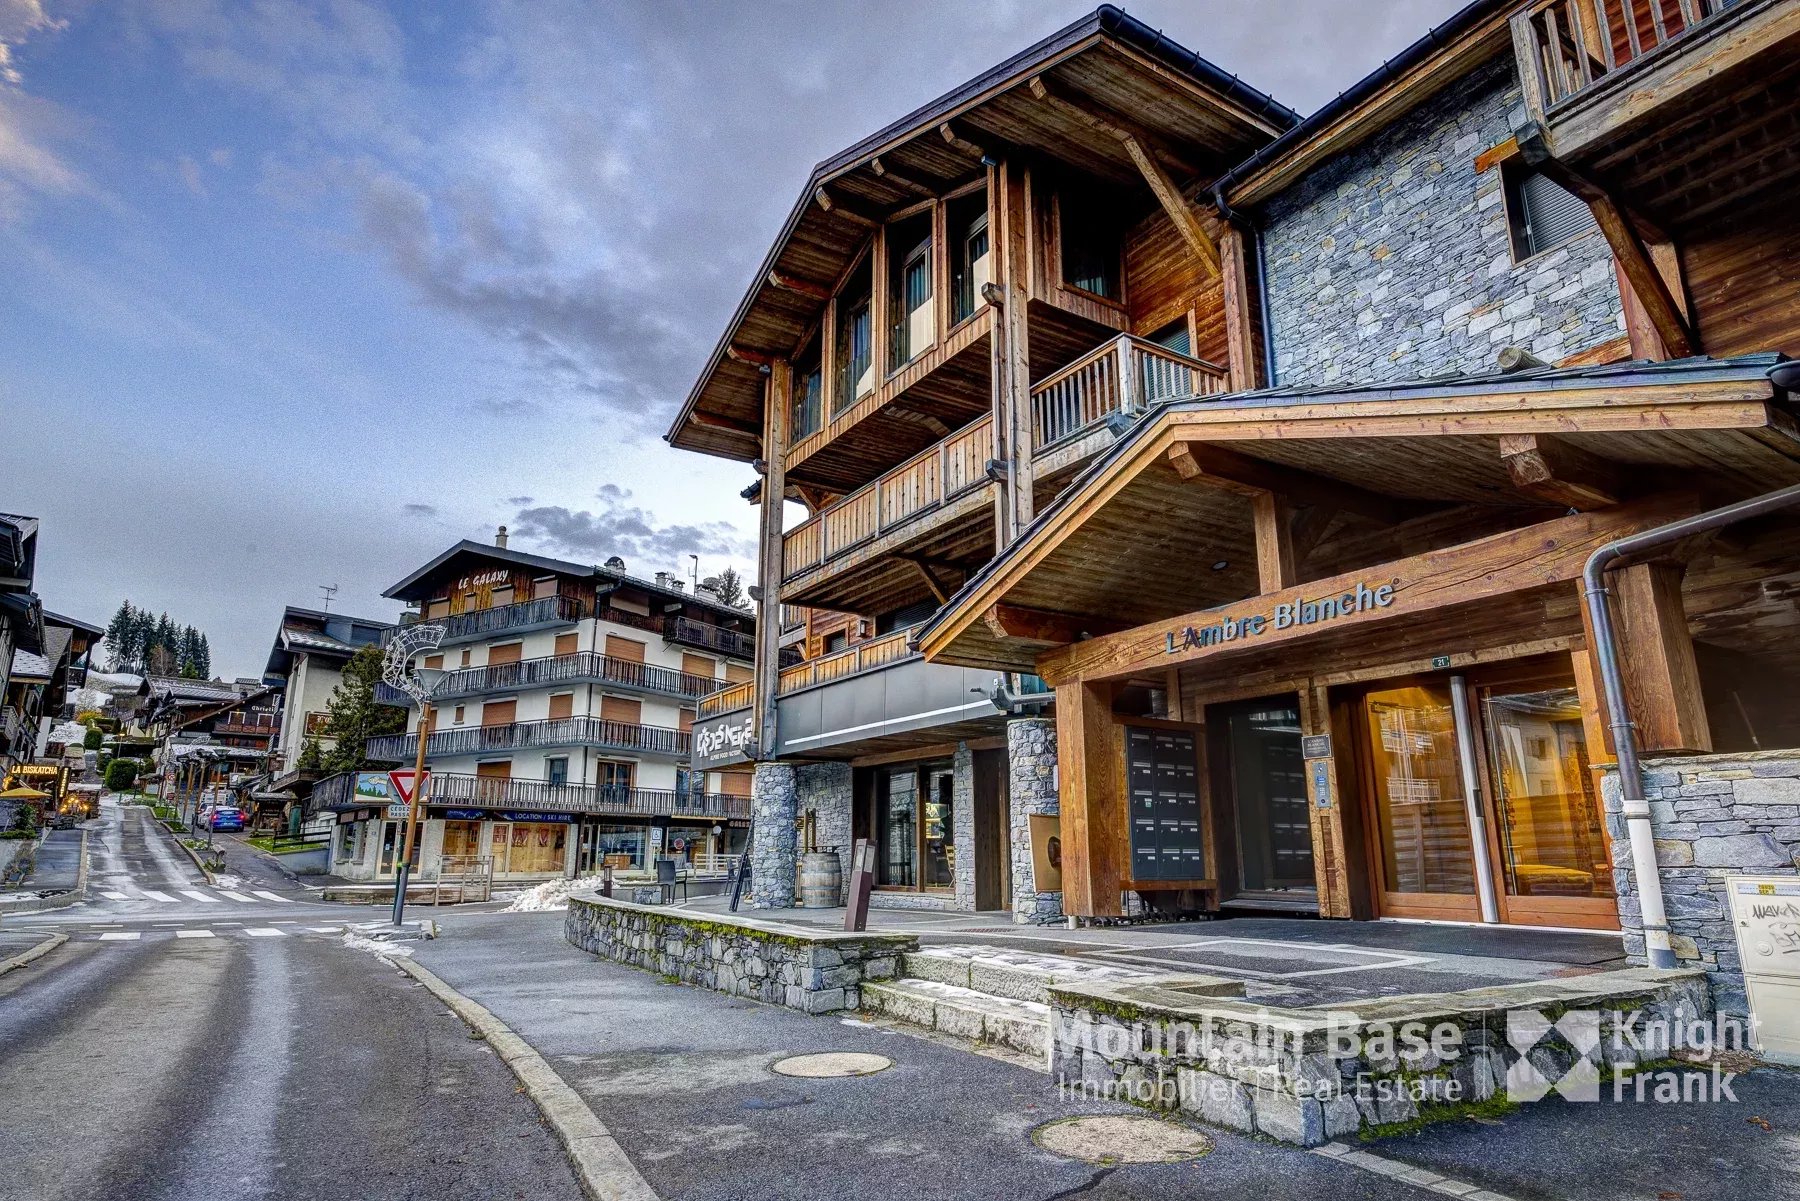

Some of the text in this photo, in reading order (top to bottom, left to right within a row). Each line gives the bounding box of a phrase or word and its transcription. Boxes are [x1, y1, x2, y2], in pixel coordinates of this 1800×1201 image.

[458, 569, 509, 590] LE GALAXY
[1165, 582, 1395, 655] L'Ambre Blanche
[1437, 658, 1445, 666] 21
[11, 765, 58, 775] LA BISKATCHA
